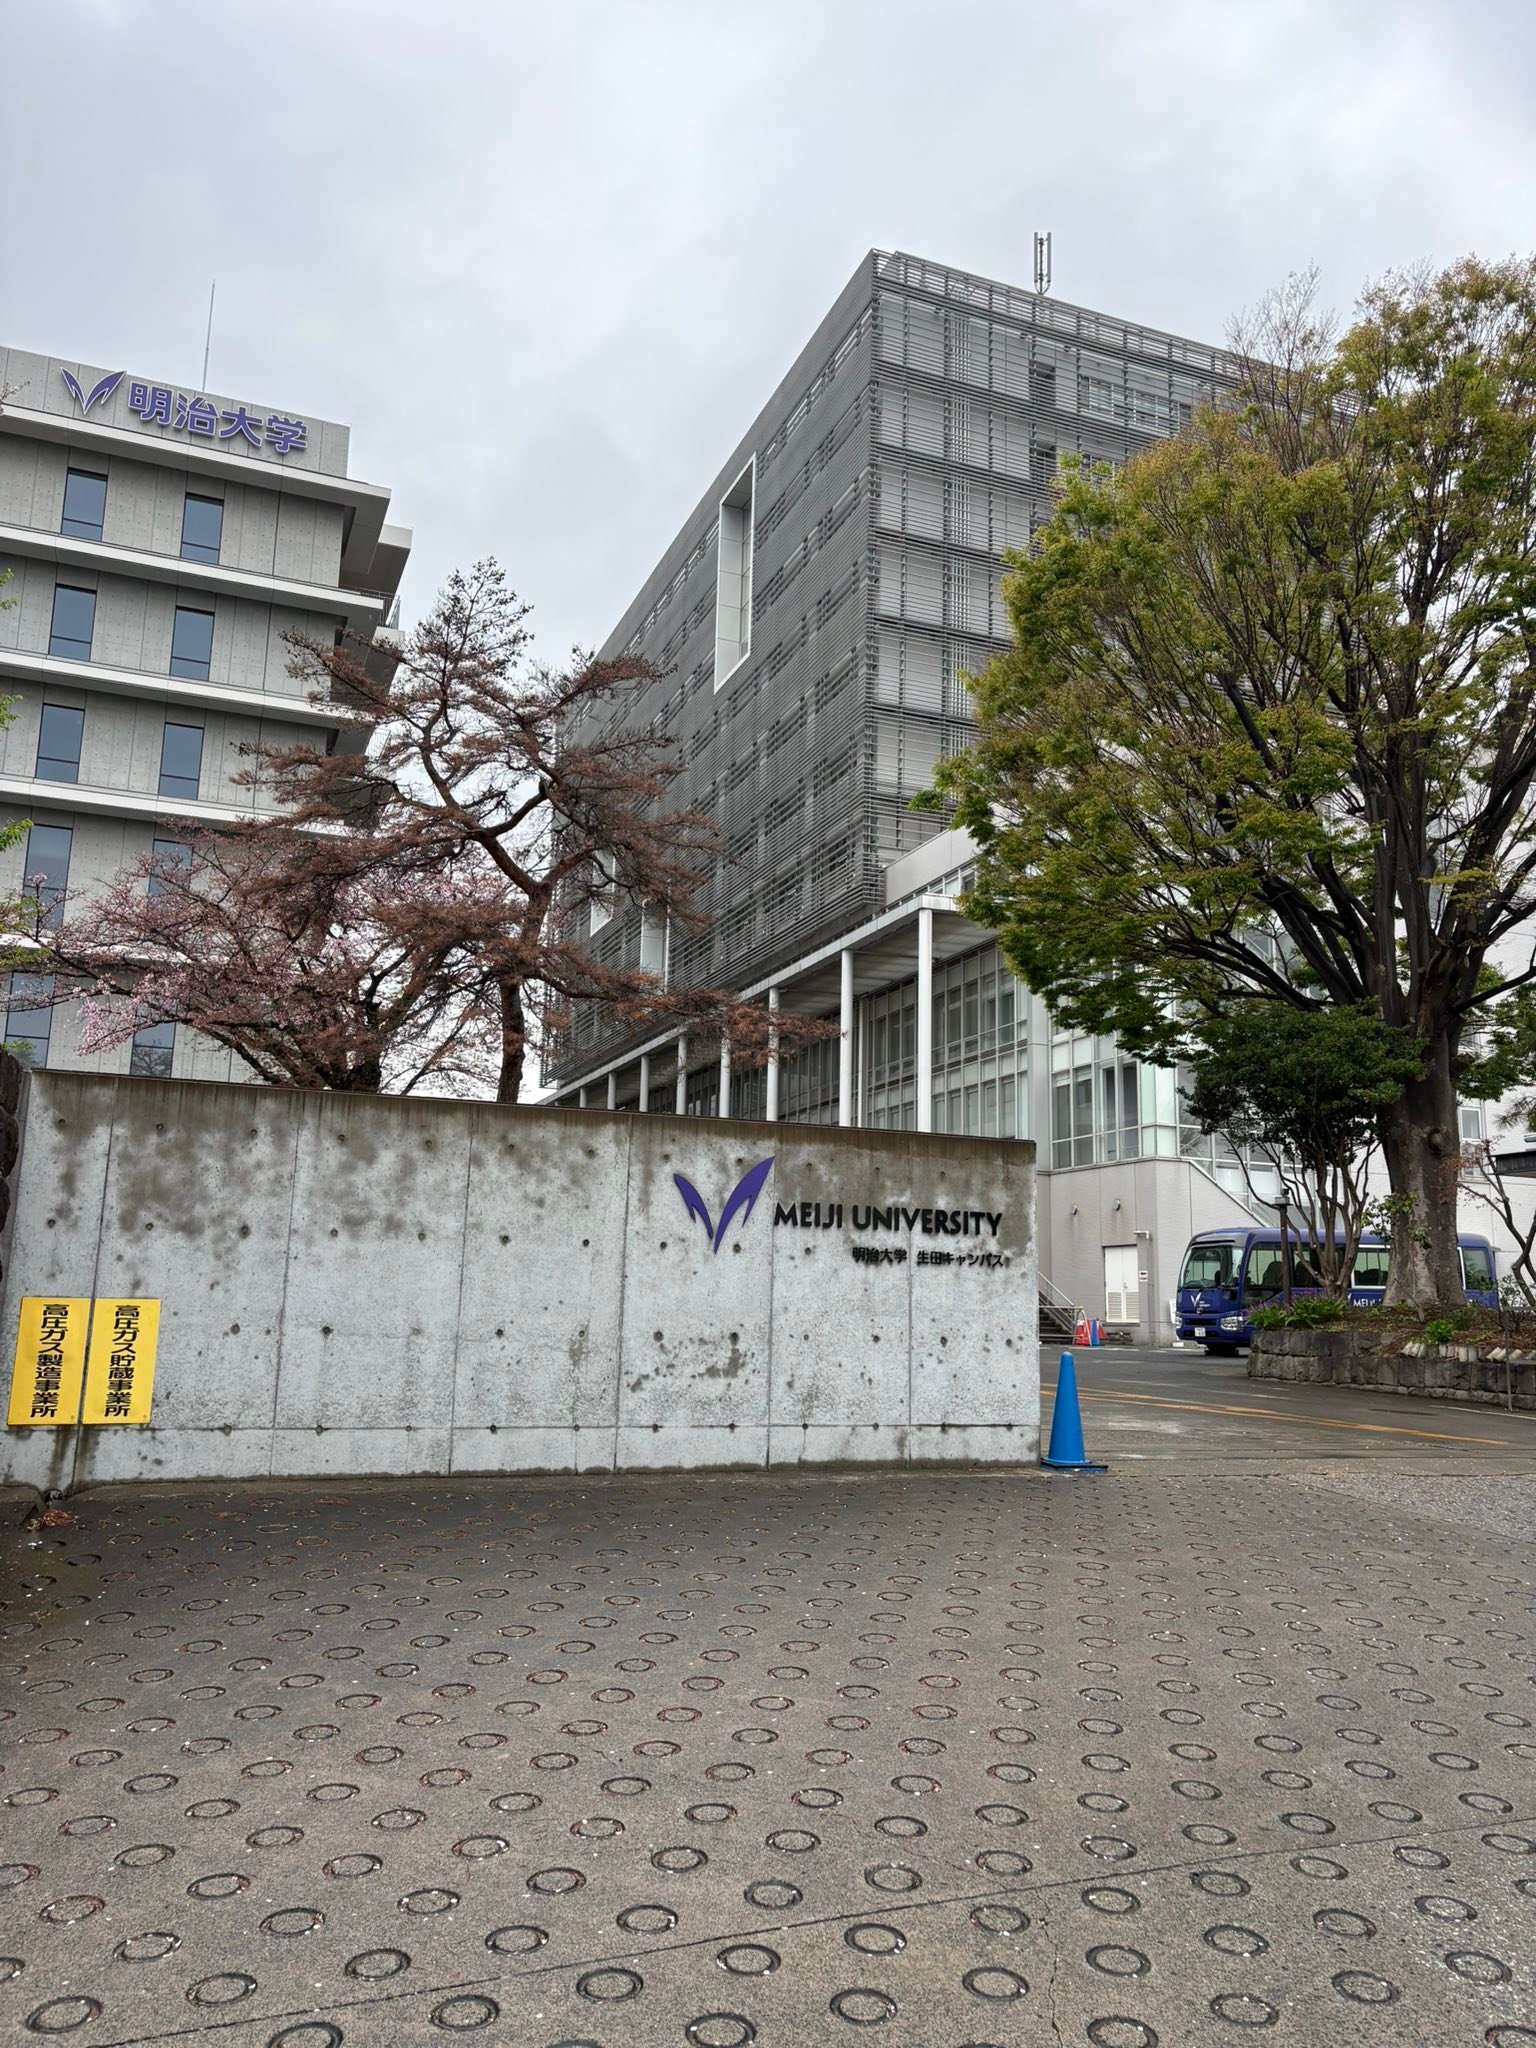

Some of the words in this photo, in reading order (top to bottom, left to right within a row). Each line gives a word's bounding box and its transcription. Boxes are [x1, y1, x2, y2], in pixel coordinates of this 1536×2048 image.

[128, 380, 308, 454] 明治大学
[775, 1201, 843, 1229] MEIJI
[852, 1205, 1002, 1236] UNIVERSITY
[852, 1247, 907, 1264] 明治大学
[917, 1251, 1004, 1267] 生田キャンパス
[30, 1304, 70, 1418] 高圧ガス製造事業所
[104, 1305, 141, 1417] 高圧ガス貯蔵事業所
